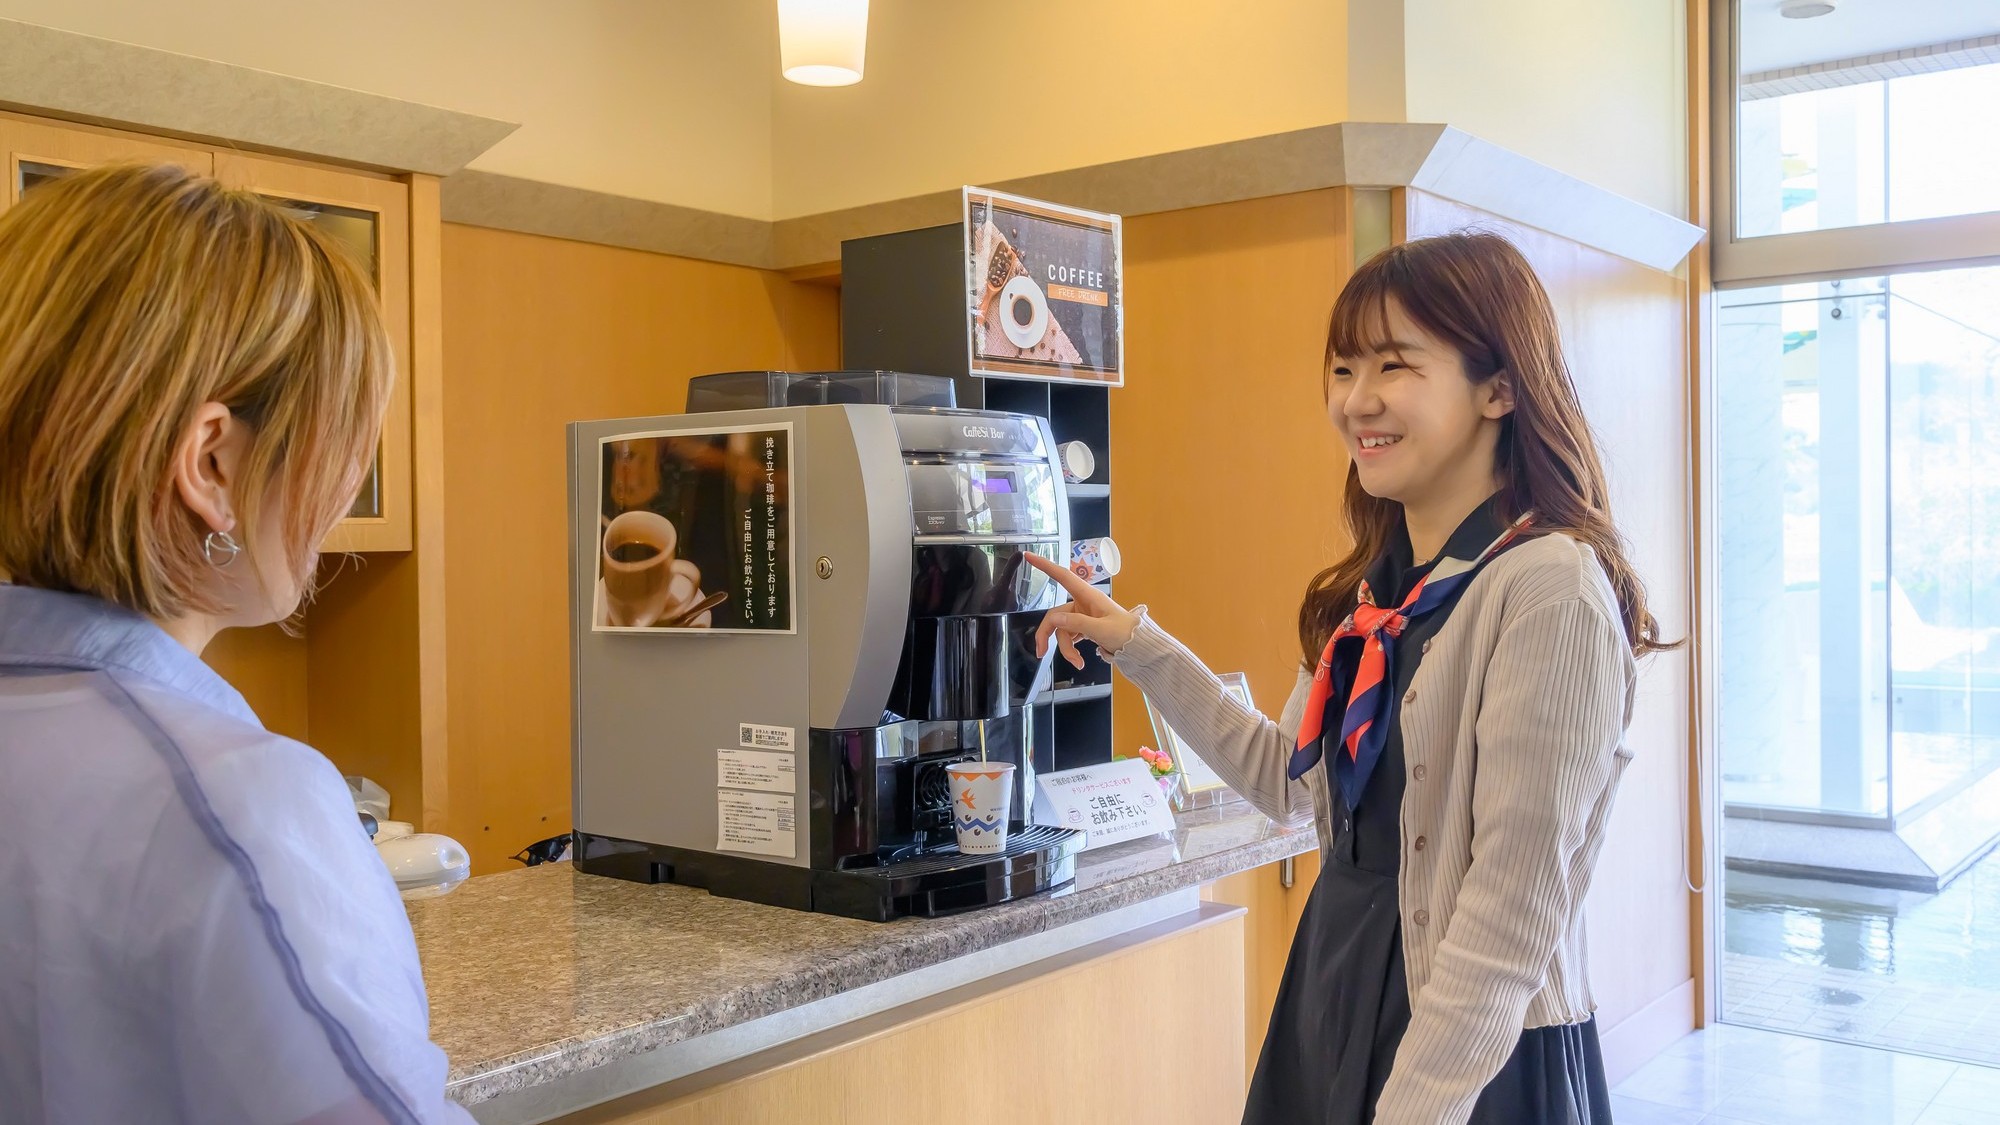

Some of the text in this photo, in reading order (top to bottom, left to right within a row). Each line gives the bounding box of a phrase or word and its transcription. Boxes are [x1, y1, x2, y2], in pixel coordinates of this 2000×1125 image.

[1048, 264, 1104, 289] COFFEE
[1058, 288, 1100, 303] FREE DRINK
[765, 437, 777, 618] 挽き立て珈琲をご用意しております
[744, 508, 754, 624] ご自由にお飲み下さい。
[1089, 793, 1125, 810] ご自由に
[1091, 805, 1147, 825] お飲み下さい。
